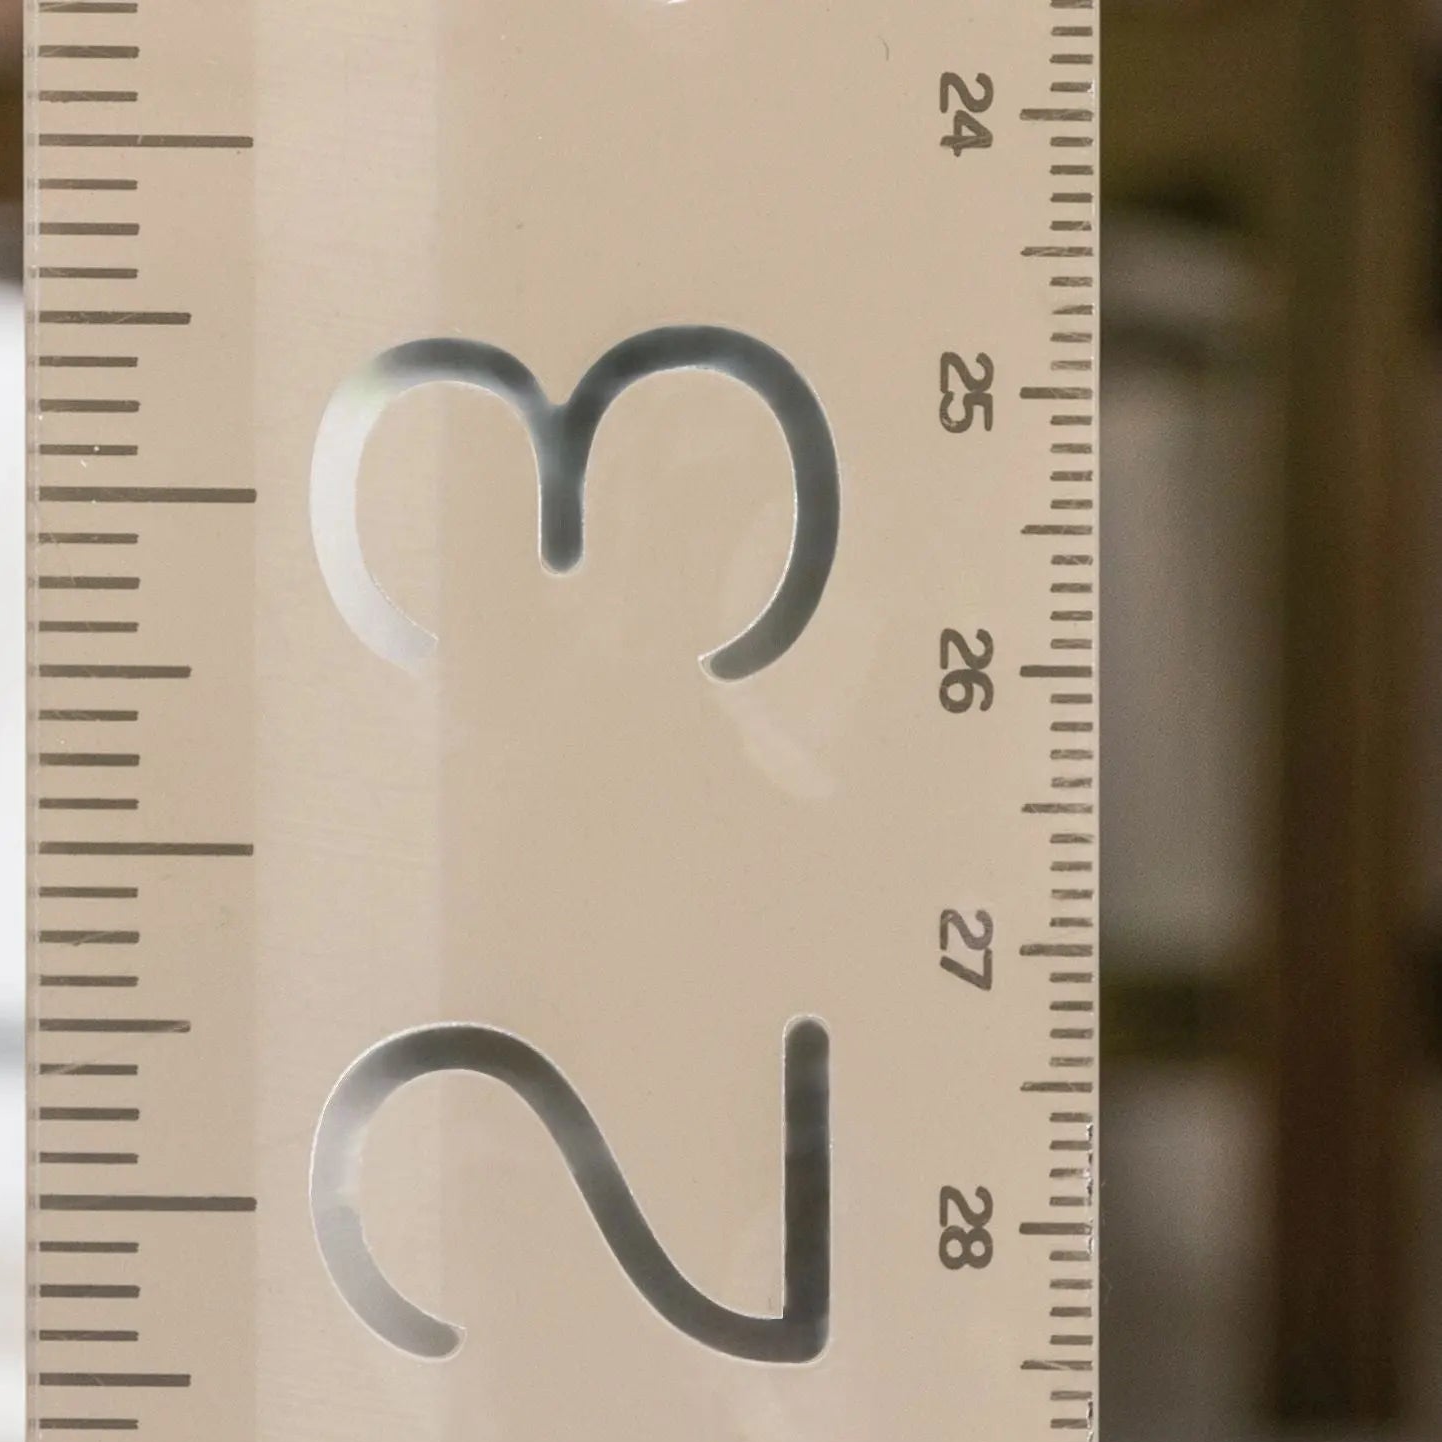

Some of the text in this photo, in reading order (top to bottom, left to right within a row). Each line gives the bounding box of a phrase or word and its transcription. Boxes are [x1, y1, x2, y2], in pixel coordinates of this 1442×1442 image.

[939, 71, 994, 158] 24
[938, 351, 994, 434] 25
[309, 324, 841, 682] 3
[938, 628, 994, 714] 26
[938, 909, 994, 991] 27
[309, 1013, 831, 1366] 2
[938, 1185, 994, 1271] 28
